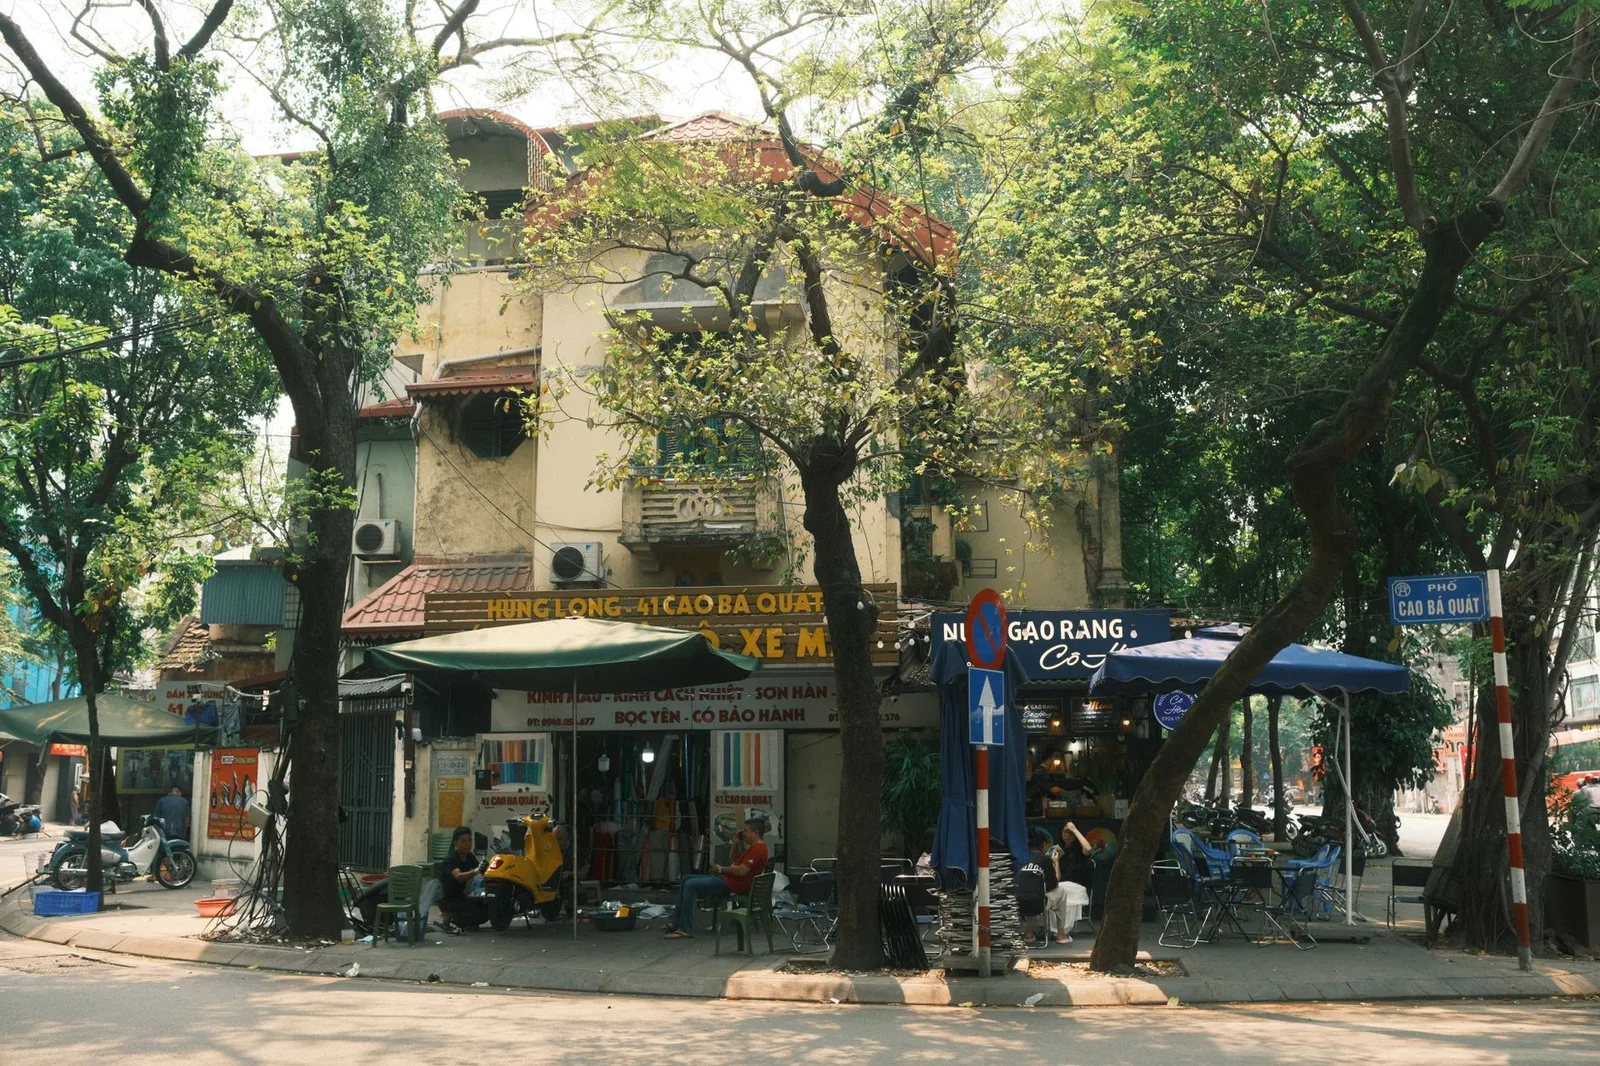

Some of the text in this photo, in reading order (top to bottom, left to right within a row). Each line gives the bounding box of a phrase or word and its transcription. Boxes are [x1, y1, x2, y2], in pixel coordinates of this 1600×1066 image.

[1427, 578, 1457, 592] PHỐ
[555, 596, 621, 617] LONG
[636, 595, 659, 616] 41
[662, 594, 715, 616] CAO
[718, 588, 750, 615] BÁ
[756, 586, 823, 613] QUÁT
[1398, 593, 1480, 617] CAO BÁ QUÁT
[739, 627, 785, 658] XE
[1007, 619, 1055, 644] GẠO
[1060, 618, 1124, 640] RANG
[1039, 643, 1081, 670] Cô
[792, 682, 828, 699] HÀN
[614, 711, 647, 727] BỌC
[650, 707, 681, 724] YÊN
[692, 706, 715, 724] CÓ
[718, 705, 755, 723] BẢO
[758, 705, 805, 722] HÀNH
